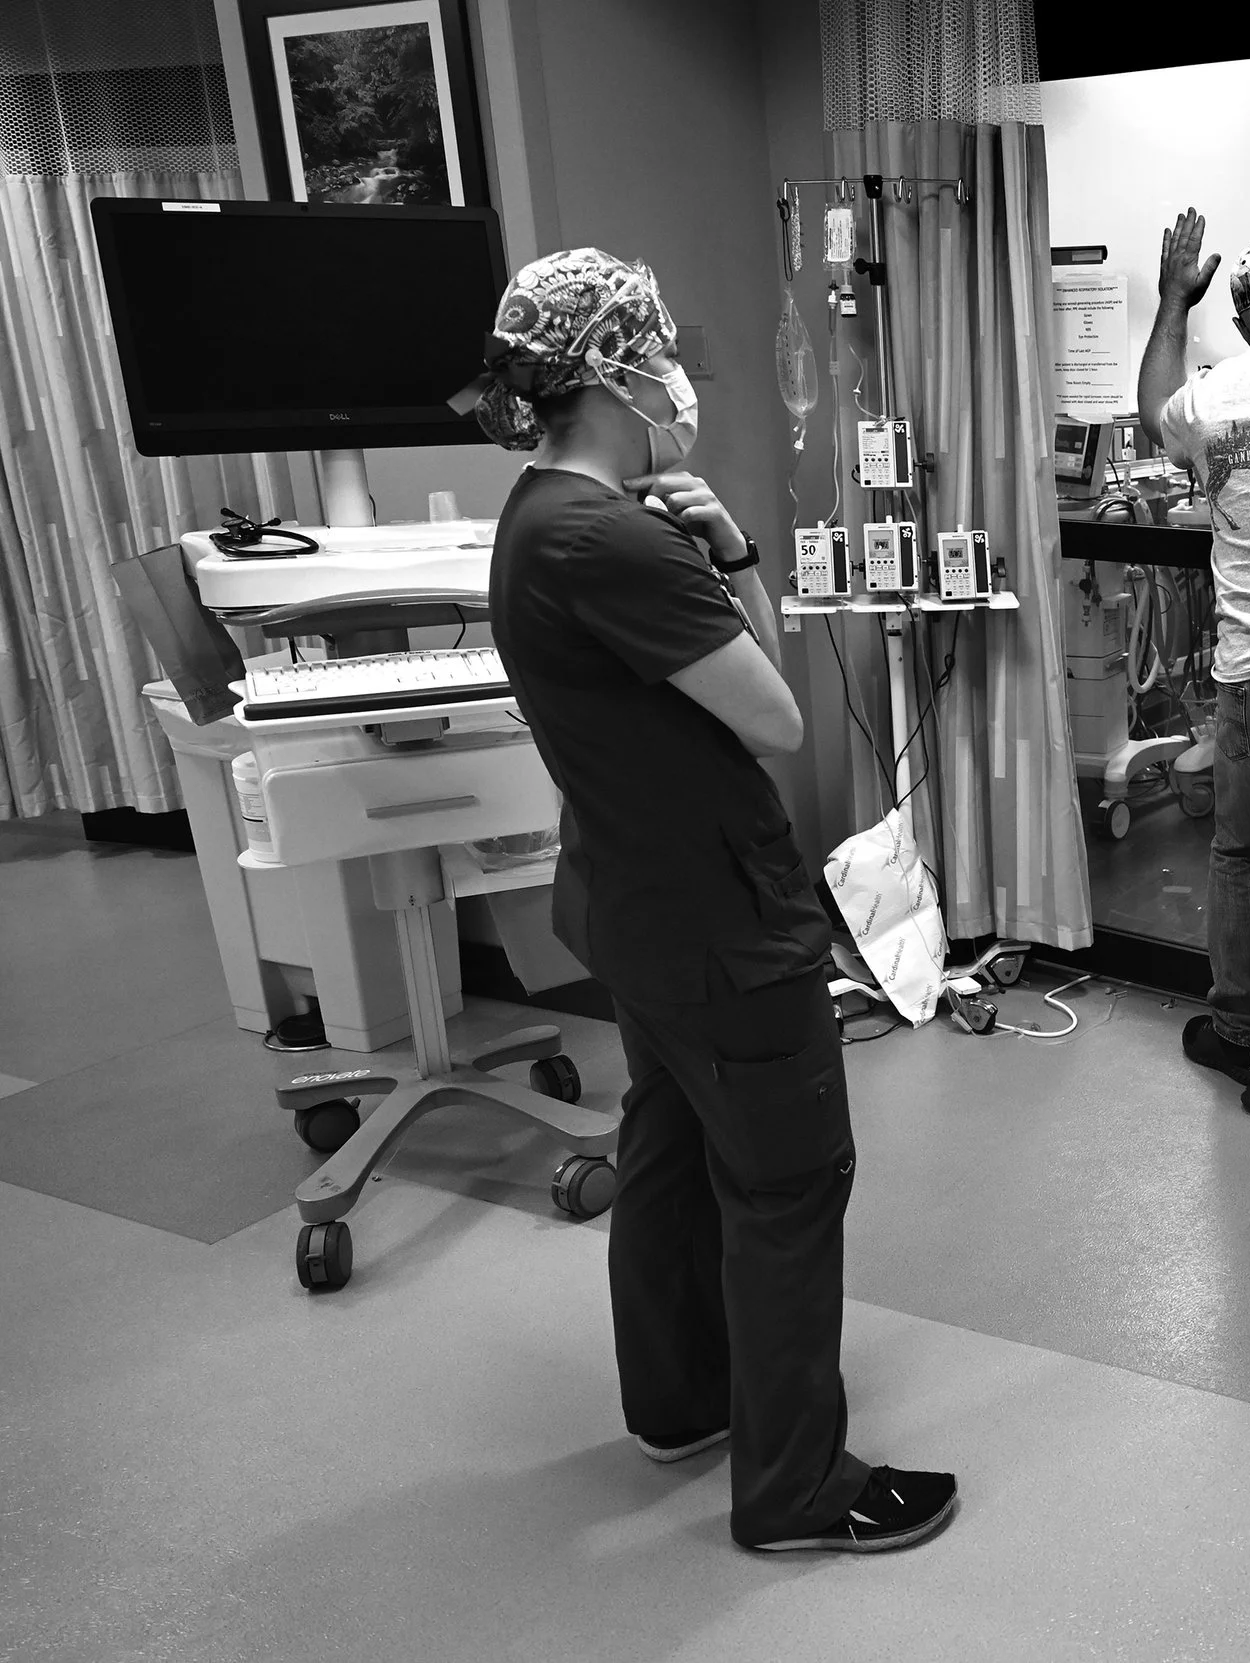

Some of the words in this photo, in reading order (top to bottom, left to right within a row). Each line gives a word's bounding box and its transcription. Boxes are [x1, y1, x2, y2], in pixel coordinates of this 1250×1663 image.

[329, 413, 350, 421] DELL
[801, 544, 816, 556] 50
[291, 1069, 371, 1084] enovate
